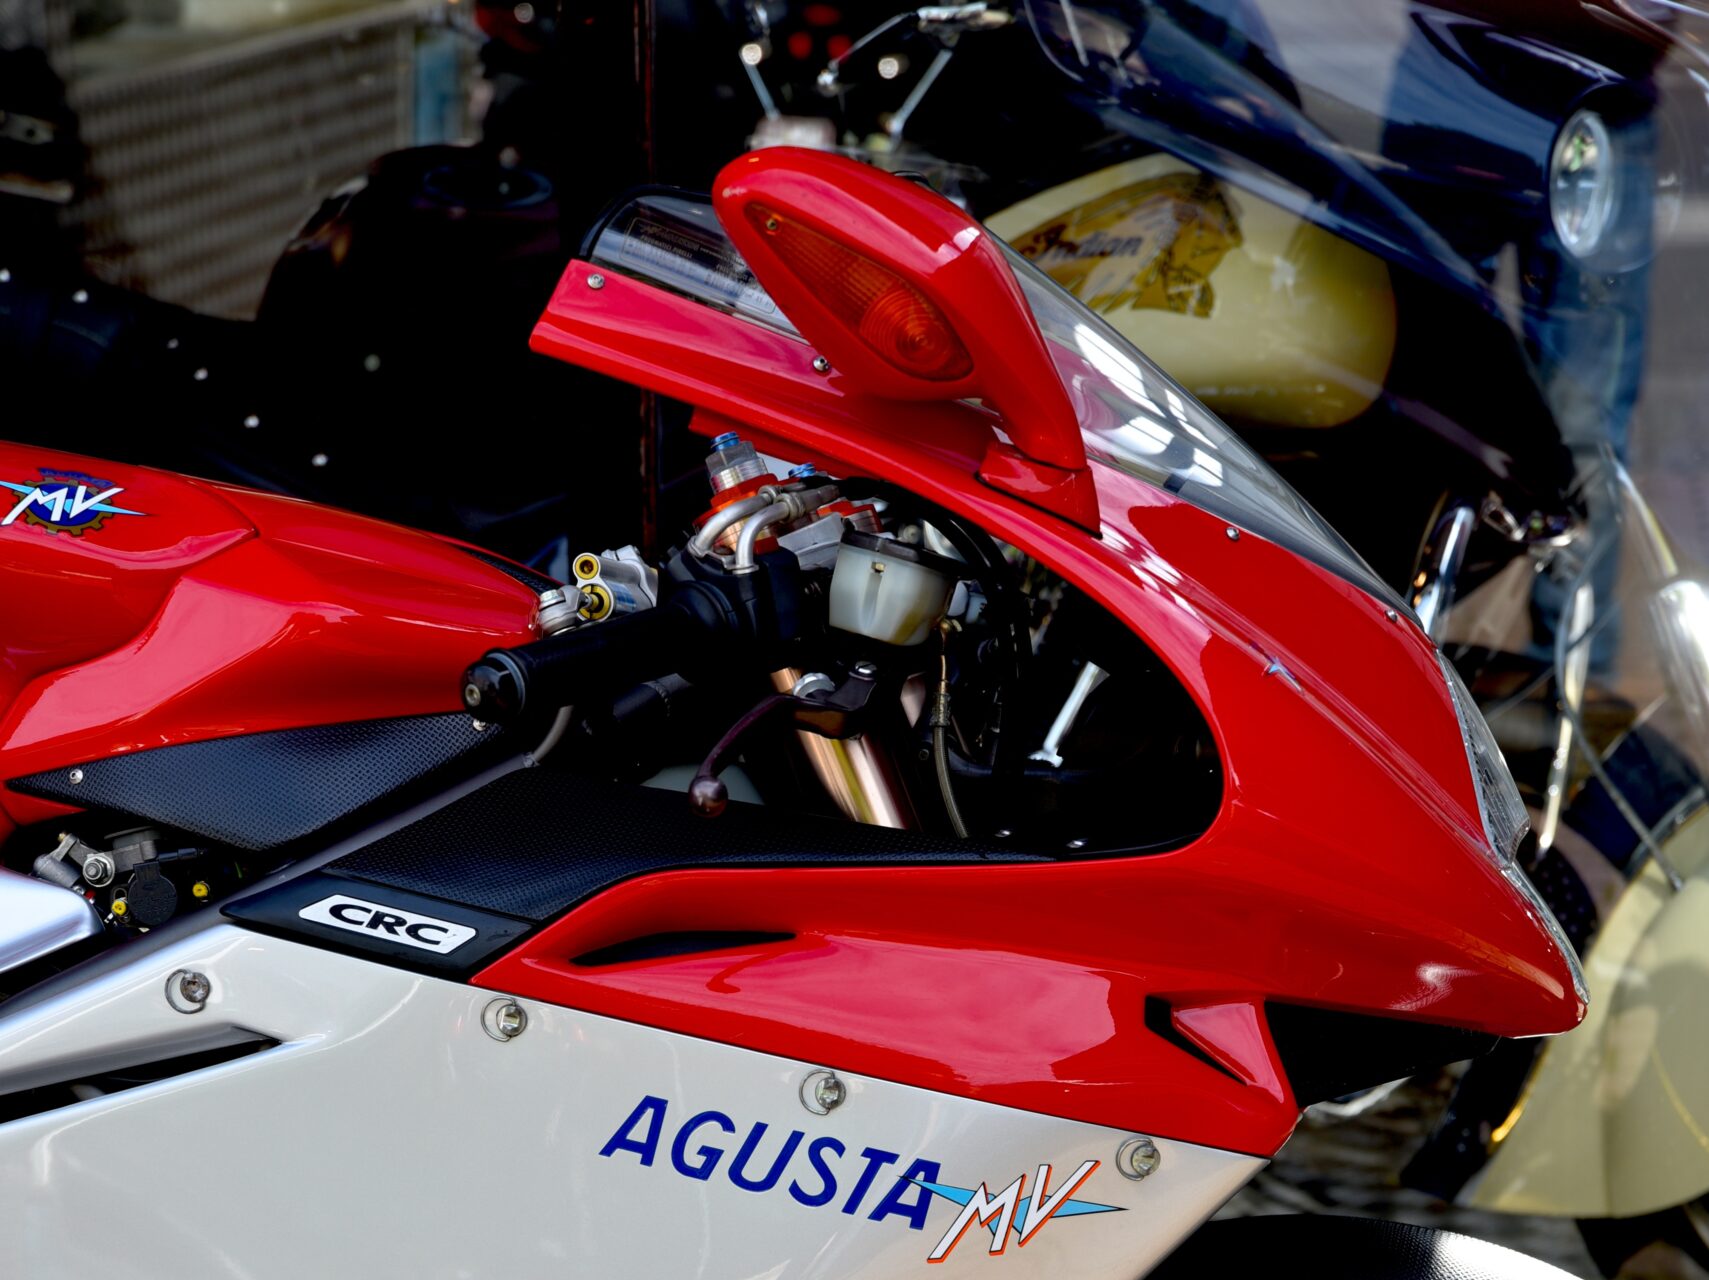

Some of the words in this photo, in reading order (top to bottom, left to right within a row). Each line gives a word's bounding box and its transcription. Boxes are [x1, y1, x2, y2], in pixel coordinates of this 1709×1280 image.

[1020, 223, 1143, 259] Indian
[0, 485, 125, 526] MV
[328, 903, 449, 946] CRC
[599, 1095, 942, 1231] AGUSTA
[926, 1159, 1101, 1264] MV
